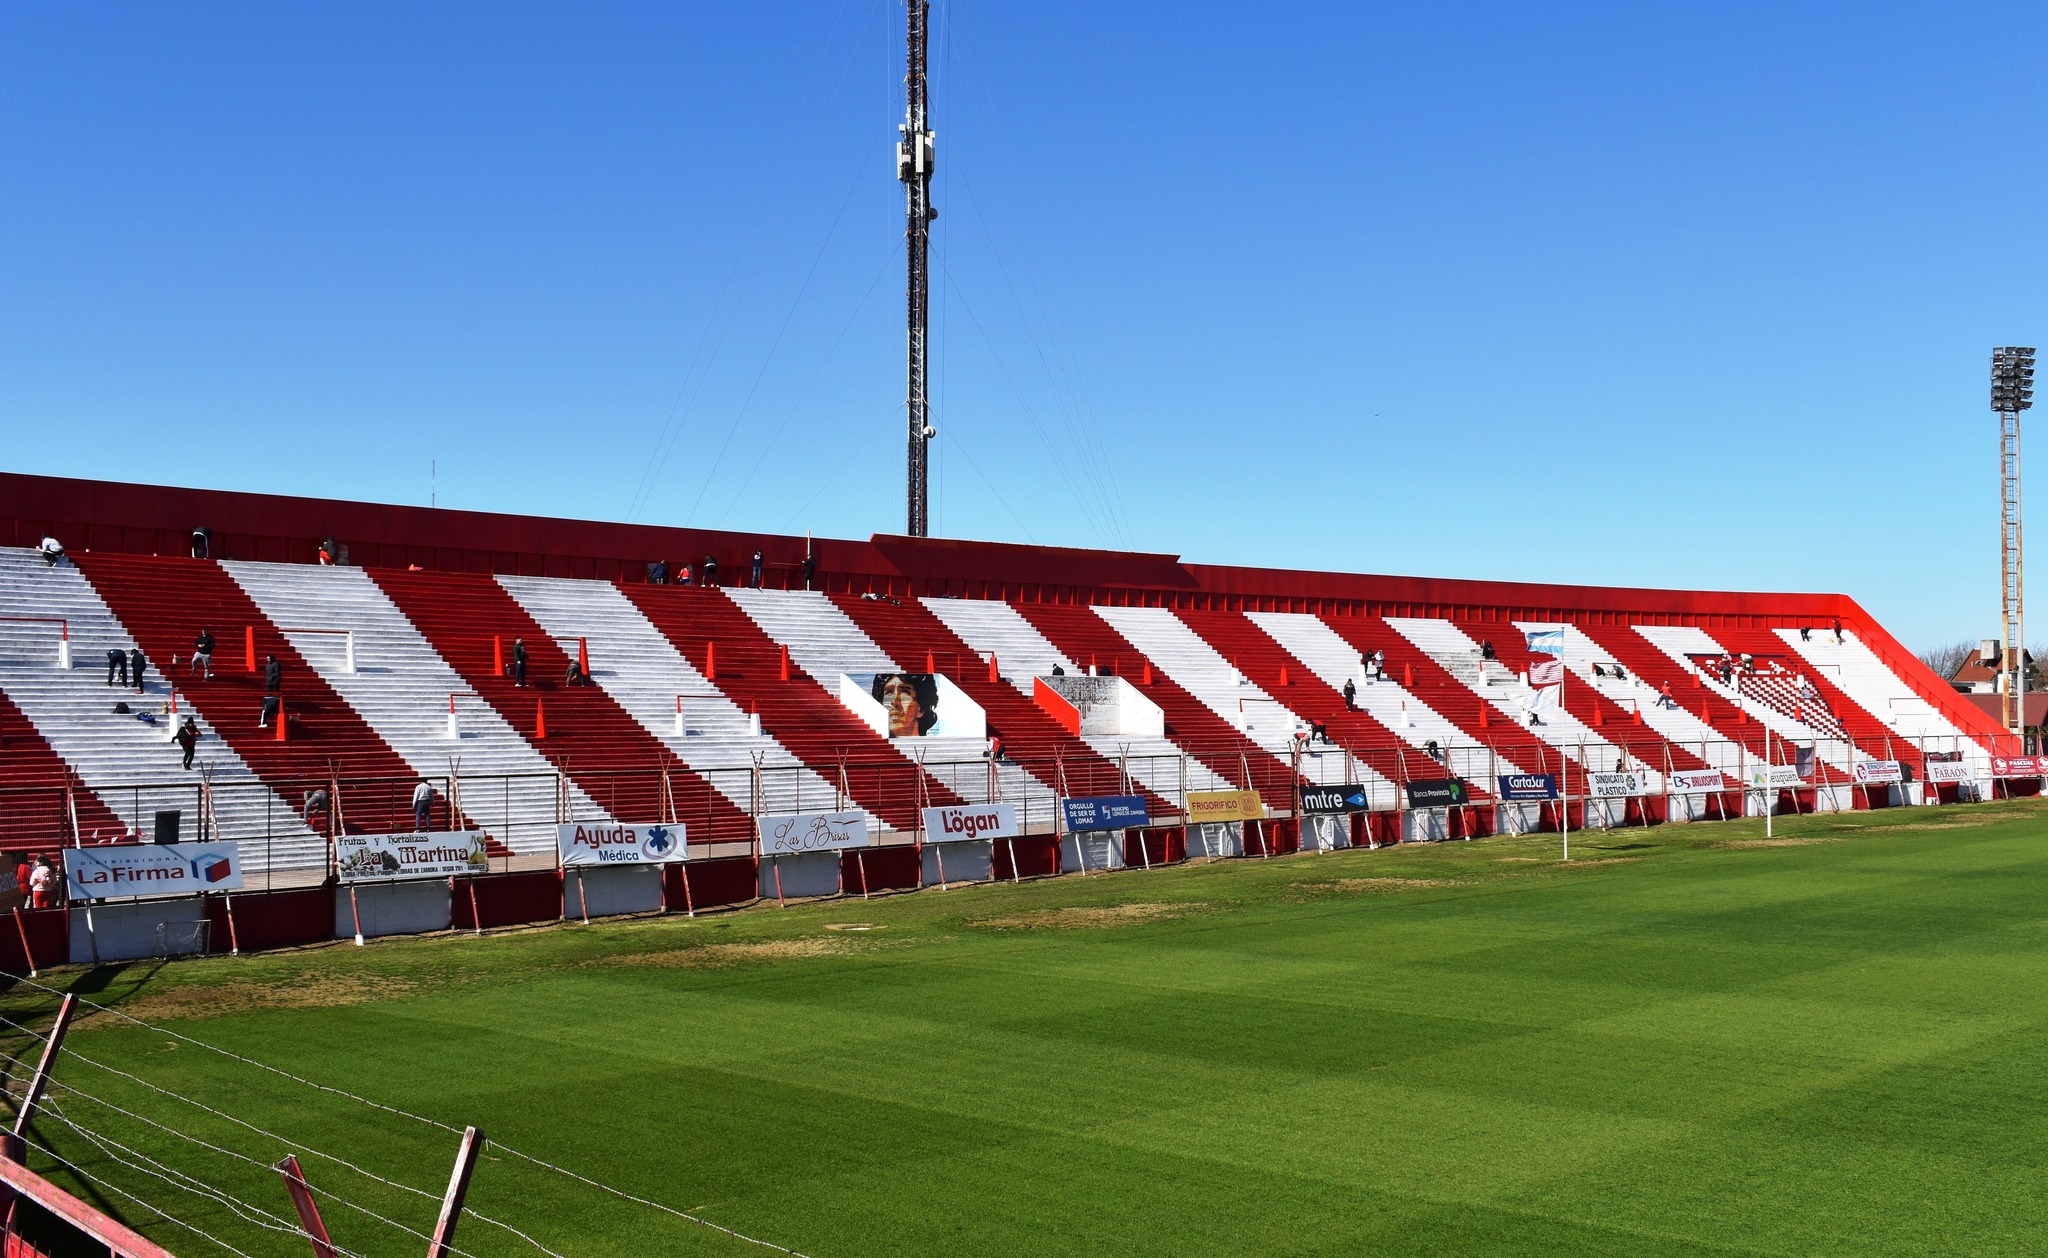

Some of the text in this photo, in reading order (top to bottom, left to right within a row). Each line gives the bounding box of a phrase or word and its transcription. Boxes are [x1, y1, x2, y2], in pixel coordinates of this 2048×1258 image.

[1934, 765, 1968, 778] FARAÓN
[1508, 776, 1545, 788] CartaSur
[1595, 774, 1625, 784] SINDICATO
[1304, 790, 1343, 809] mitre
[1413, 789, 1450, 798] Banco Provincia
[1191, 798, 1238, 811] FRIGORÍFICO
[573, 825, 637, 849] Ayuda
[774, 815, 850, 850] Las Brisas
[338, 837, 367, 846] Frutas
[80, 856, 179, 866] DISTRIBUIDORA
[359, 845, 470, 866] La Martina
[599, 850, 639, 861] Médica
